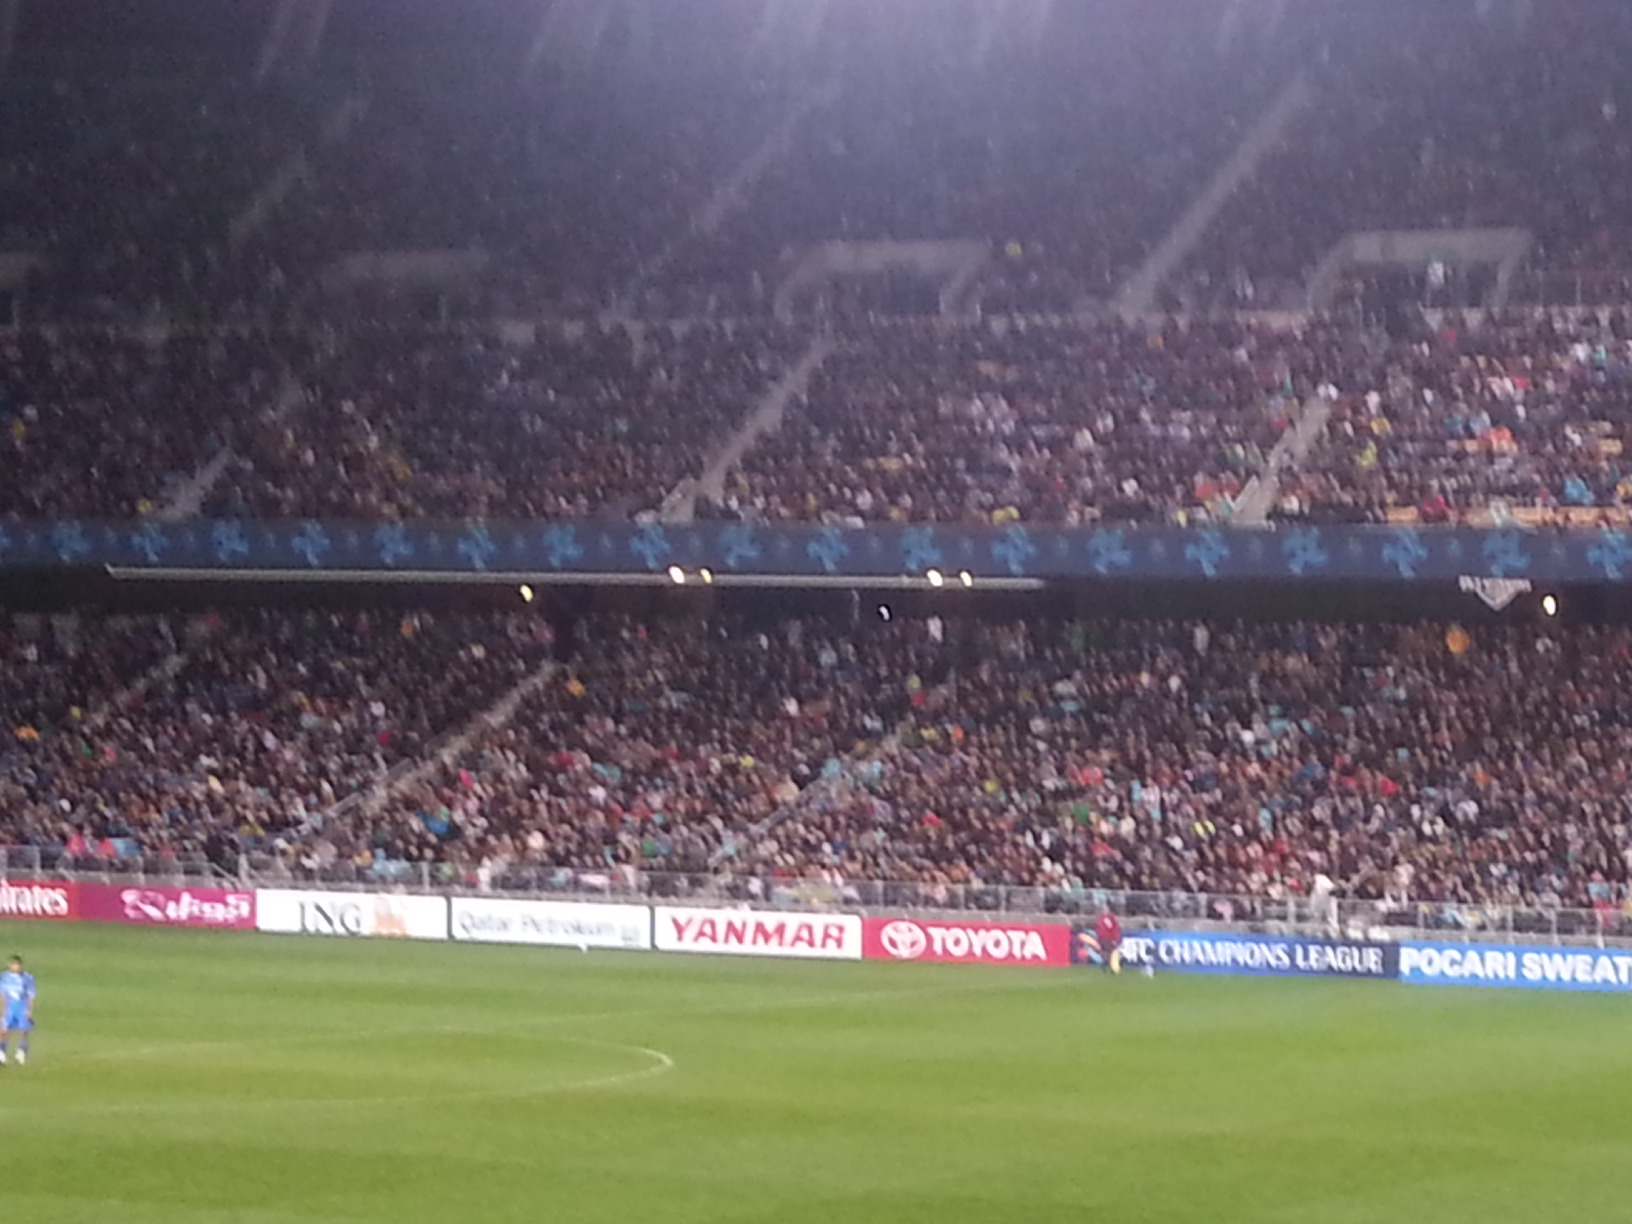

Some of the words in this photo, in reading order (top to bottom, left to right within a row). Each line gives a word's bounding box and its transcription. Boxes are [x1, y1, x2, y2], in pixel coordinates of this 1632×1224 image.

[300, 901, 362, 936] ING
[671, 916, 846, 950] YANMAR
[926, 926, 1047, 961] TOYOTA
[1158, 940, 1291, 970] CHAMPIONS
[1296, 944, 1384, 974] LEAGUE
[1401, 945, 1517, 978] POCARI
